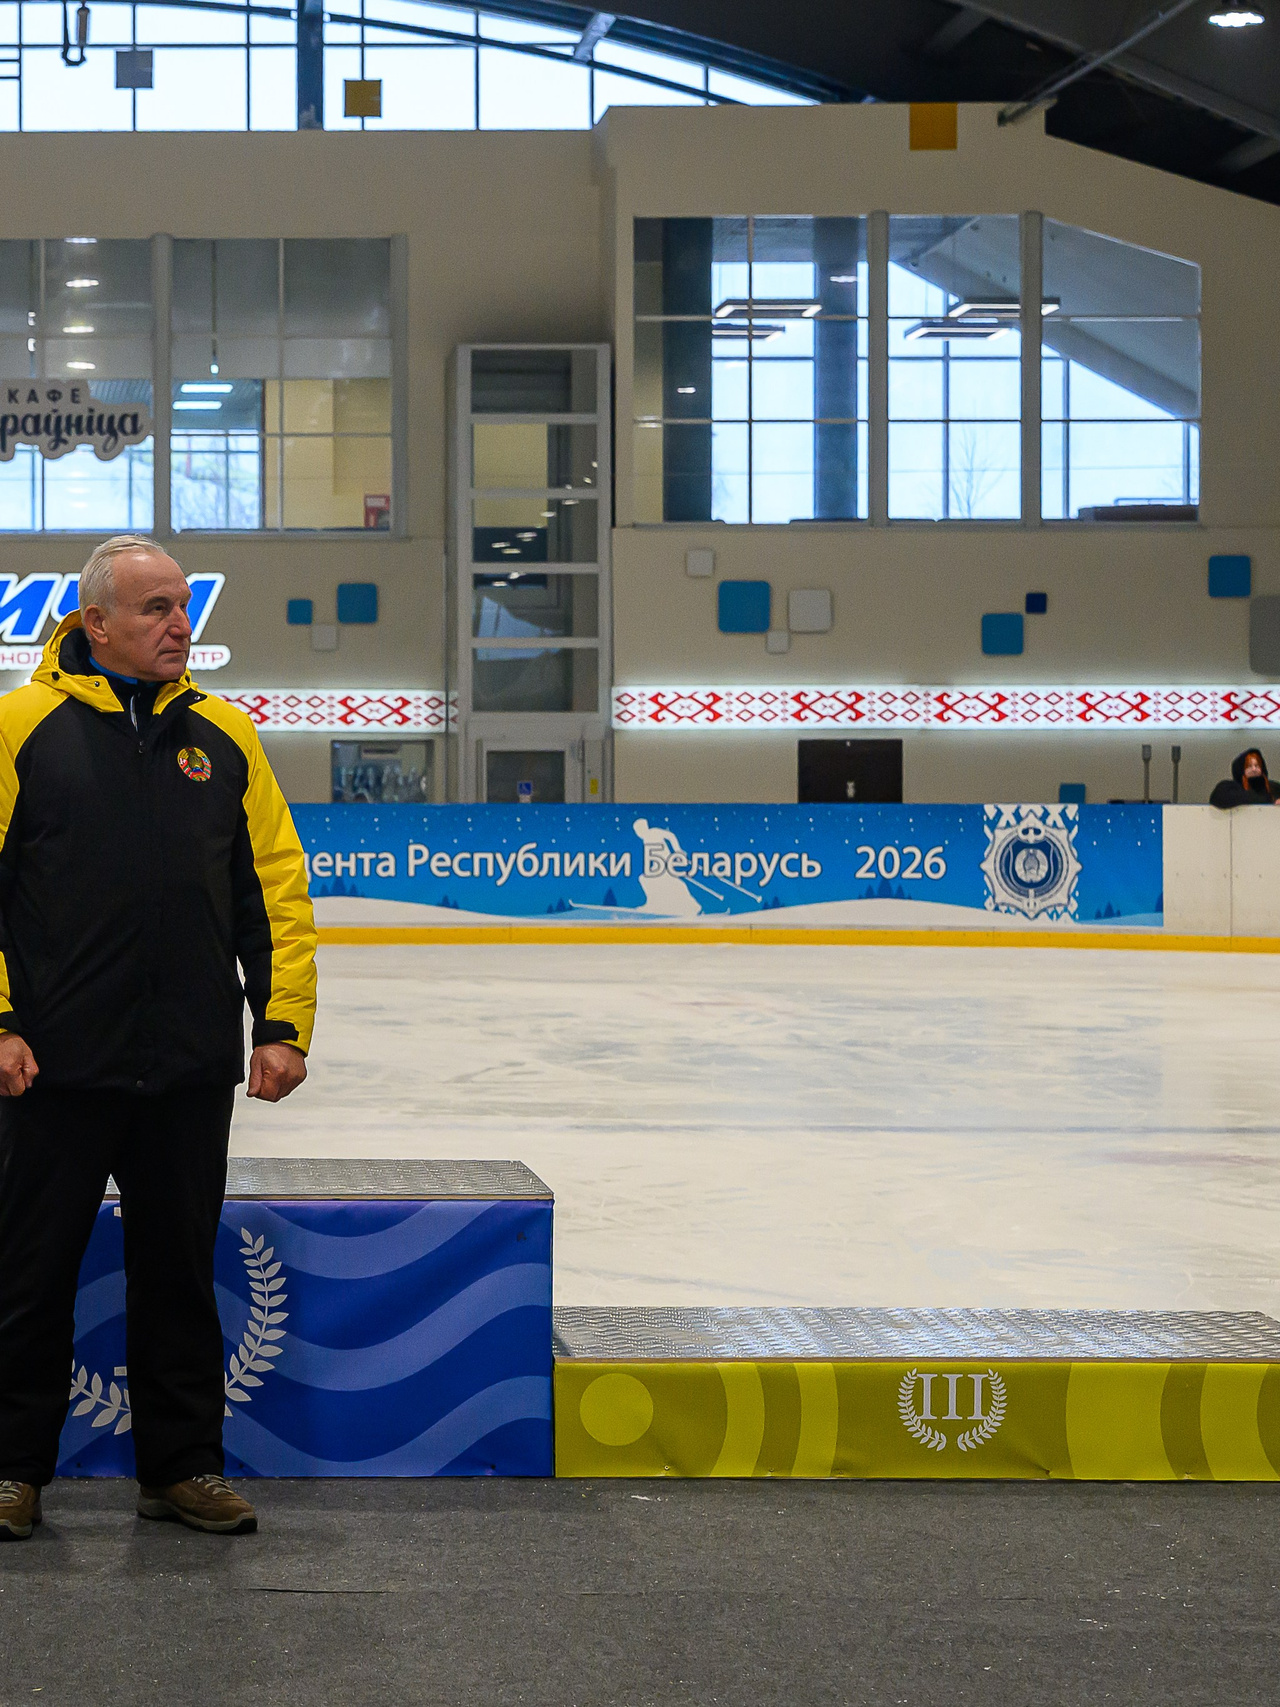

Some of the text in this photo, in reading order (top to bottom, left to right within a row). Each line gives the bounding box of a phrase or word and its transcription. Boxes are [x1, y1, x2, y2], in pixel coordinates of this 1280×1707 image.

[7, 387, 81, 405] КАФЕ
[407, 842, 631, 887] Республики
[643, 843, 822, 887] Беларусь
[854, 845, 947, 880] 2026
[916, 1373, 991, 1420] III
